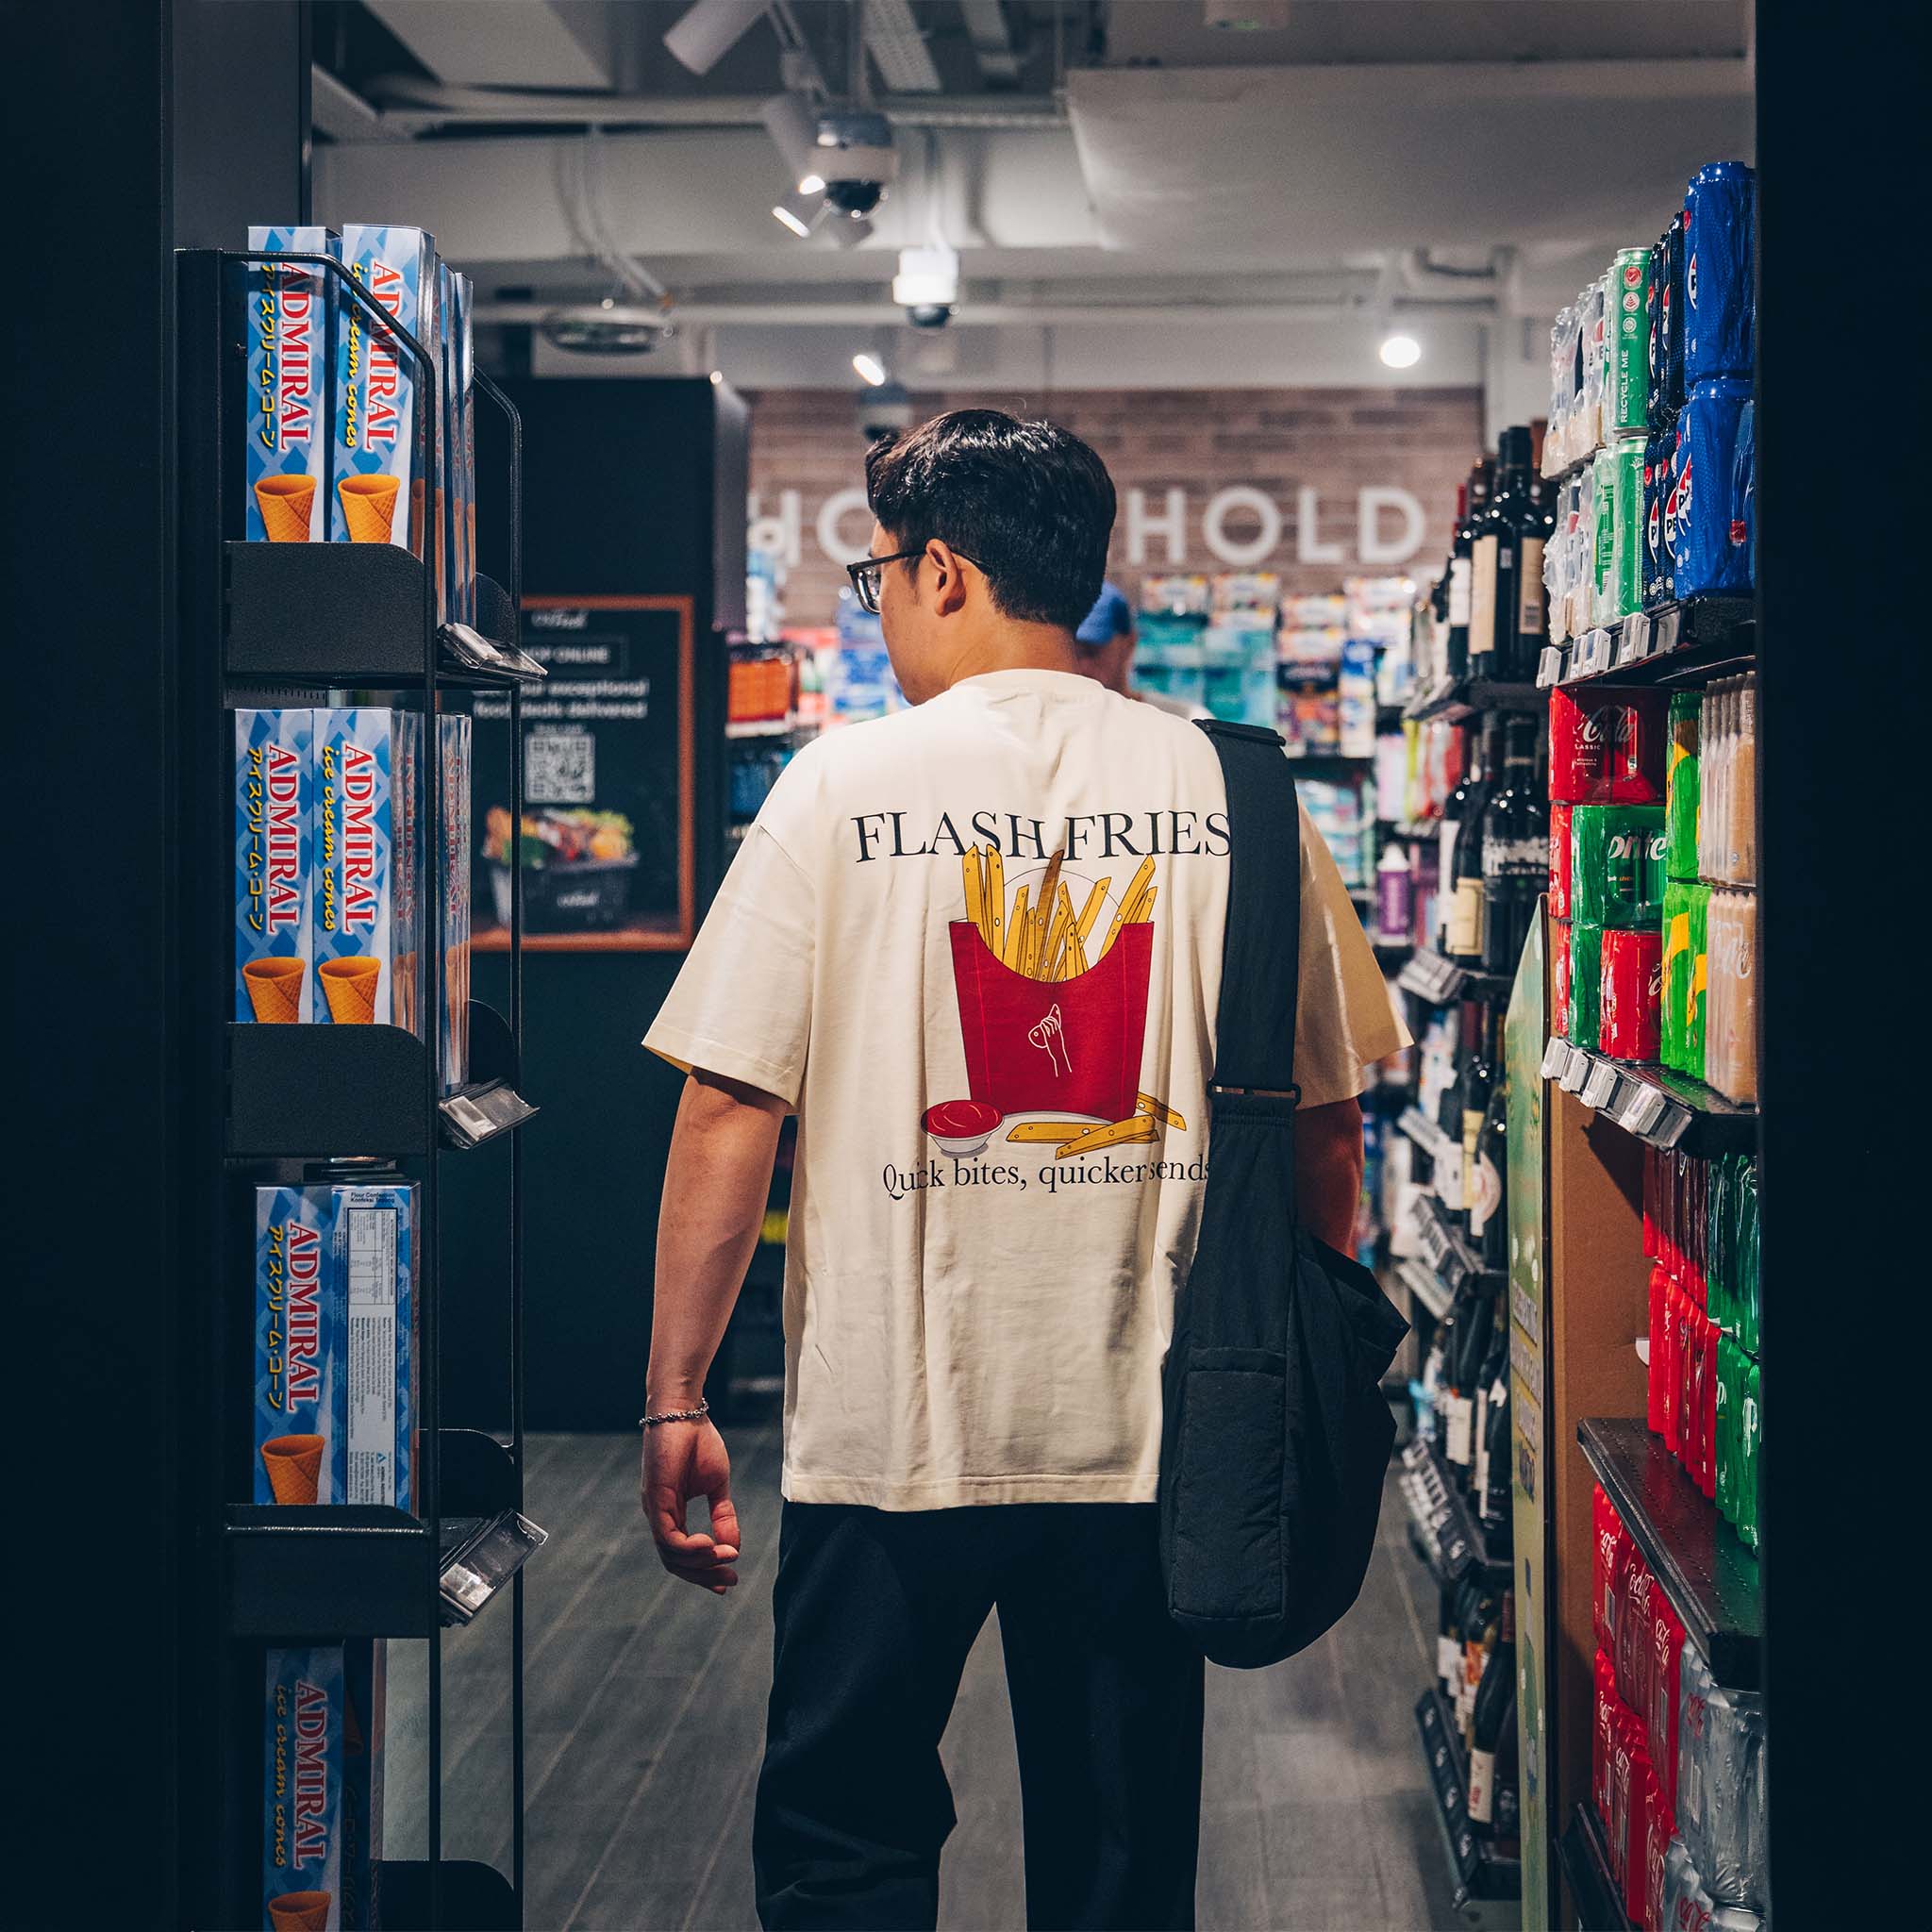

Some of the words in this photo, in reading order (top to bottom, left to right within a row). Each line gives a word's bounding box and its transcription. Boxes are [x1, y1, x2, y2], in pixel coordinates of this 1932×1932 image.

[281, 261, 310, 452] ADMIRAL
[1621, 349, 1630, 369] ME
[344, 383, 359, 448] cones
[1620, 371, 1629, 424] RECYCLE
[324, 745, 341, 779] ice
[268, 743, 300, 935] ADMIRAL
[323, 784, 338, 862] cream
[344, 743, 374, 935] ADMIRAL
[850, 810, 1051, 863] FLASH
[1058, 809, 1231, 860] FRIES
[322, 867, 338, 931] cones
[883, 1159, 945, 1201] Quick
[953, 1157, 1028, 1191] bites,
[1038, 1156, 1147, 1193] quicker
[288, 1222, 320, 1412] ADMIRAL
[275, 1724, 288, 1798] cream
[293, 1681, 327, 1869] ADMIRAL
[275, 1803, 287, 1867] cones
